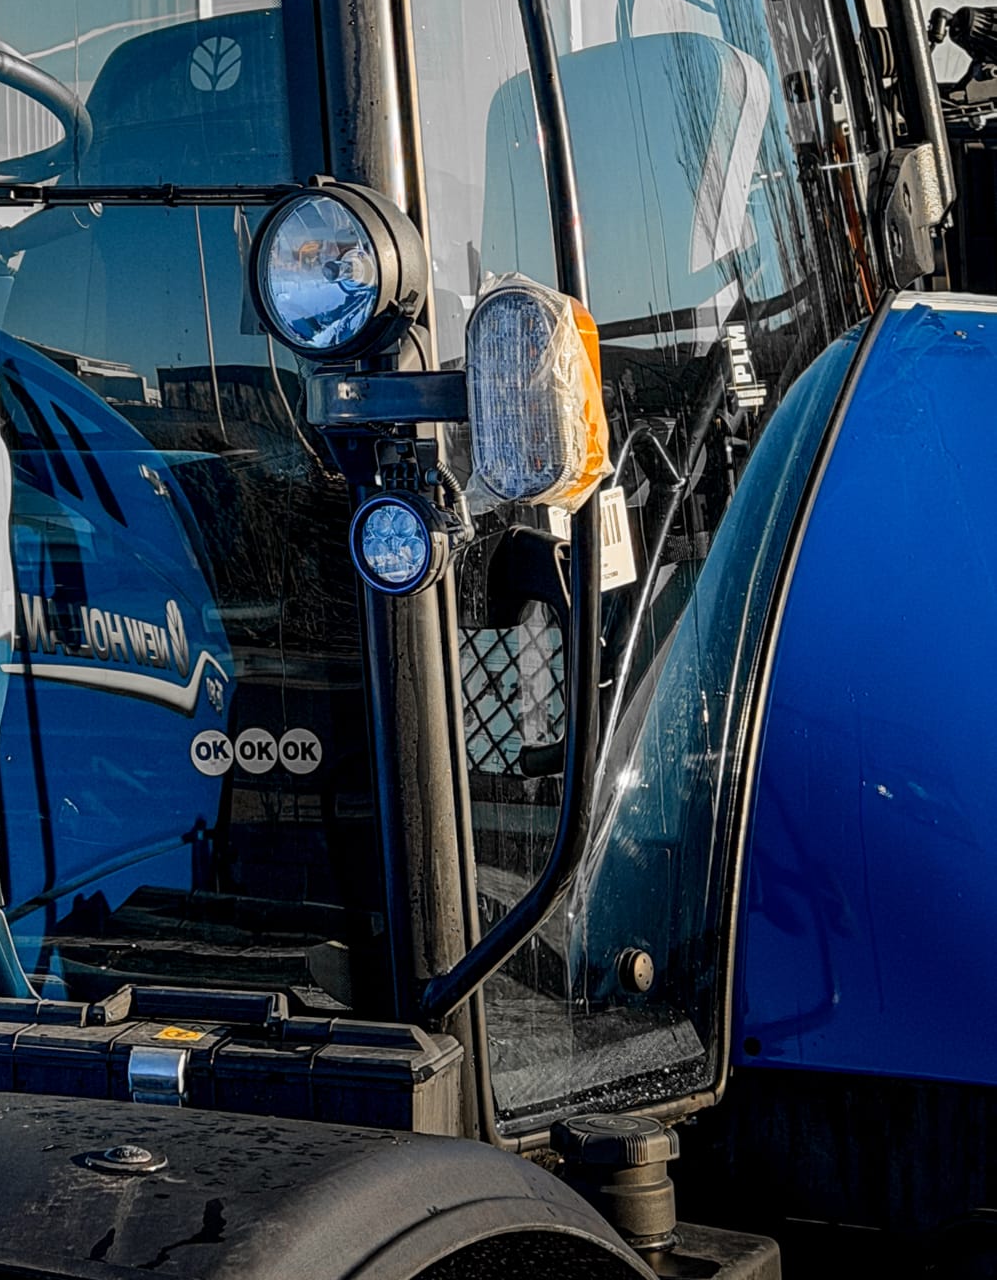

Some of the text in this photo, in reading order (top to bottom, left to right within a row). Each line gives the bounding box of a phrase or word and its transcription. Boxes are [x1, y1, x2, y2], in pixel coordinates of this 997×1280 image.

[195, 739, 319, 762] OK OK OK
